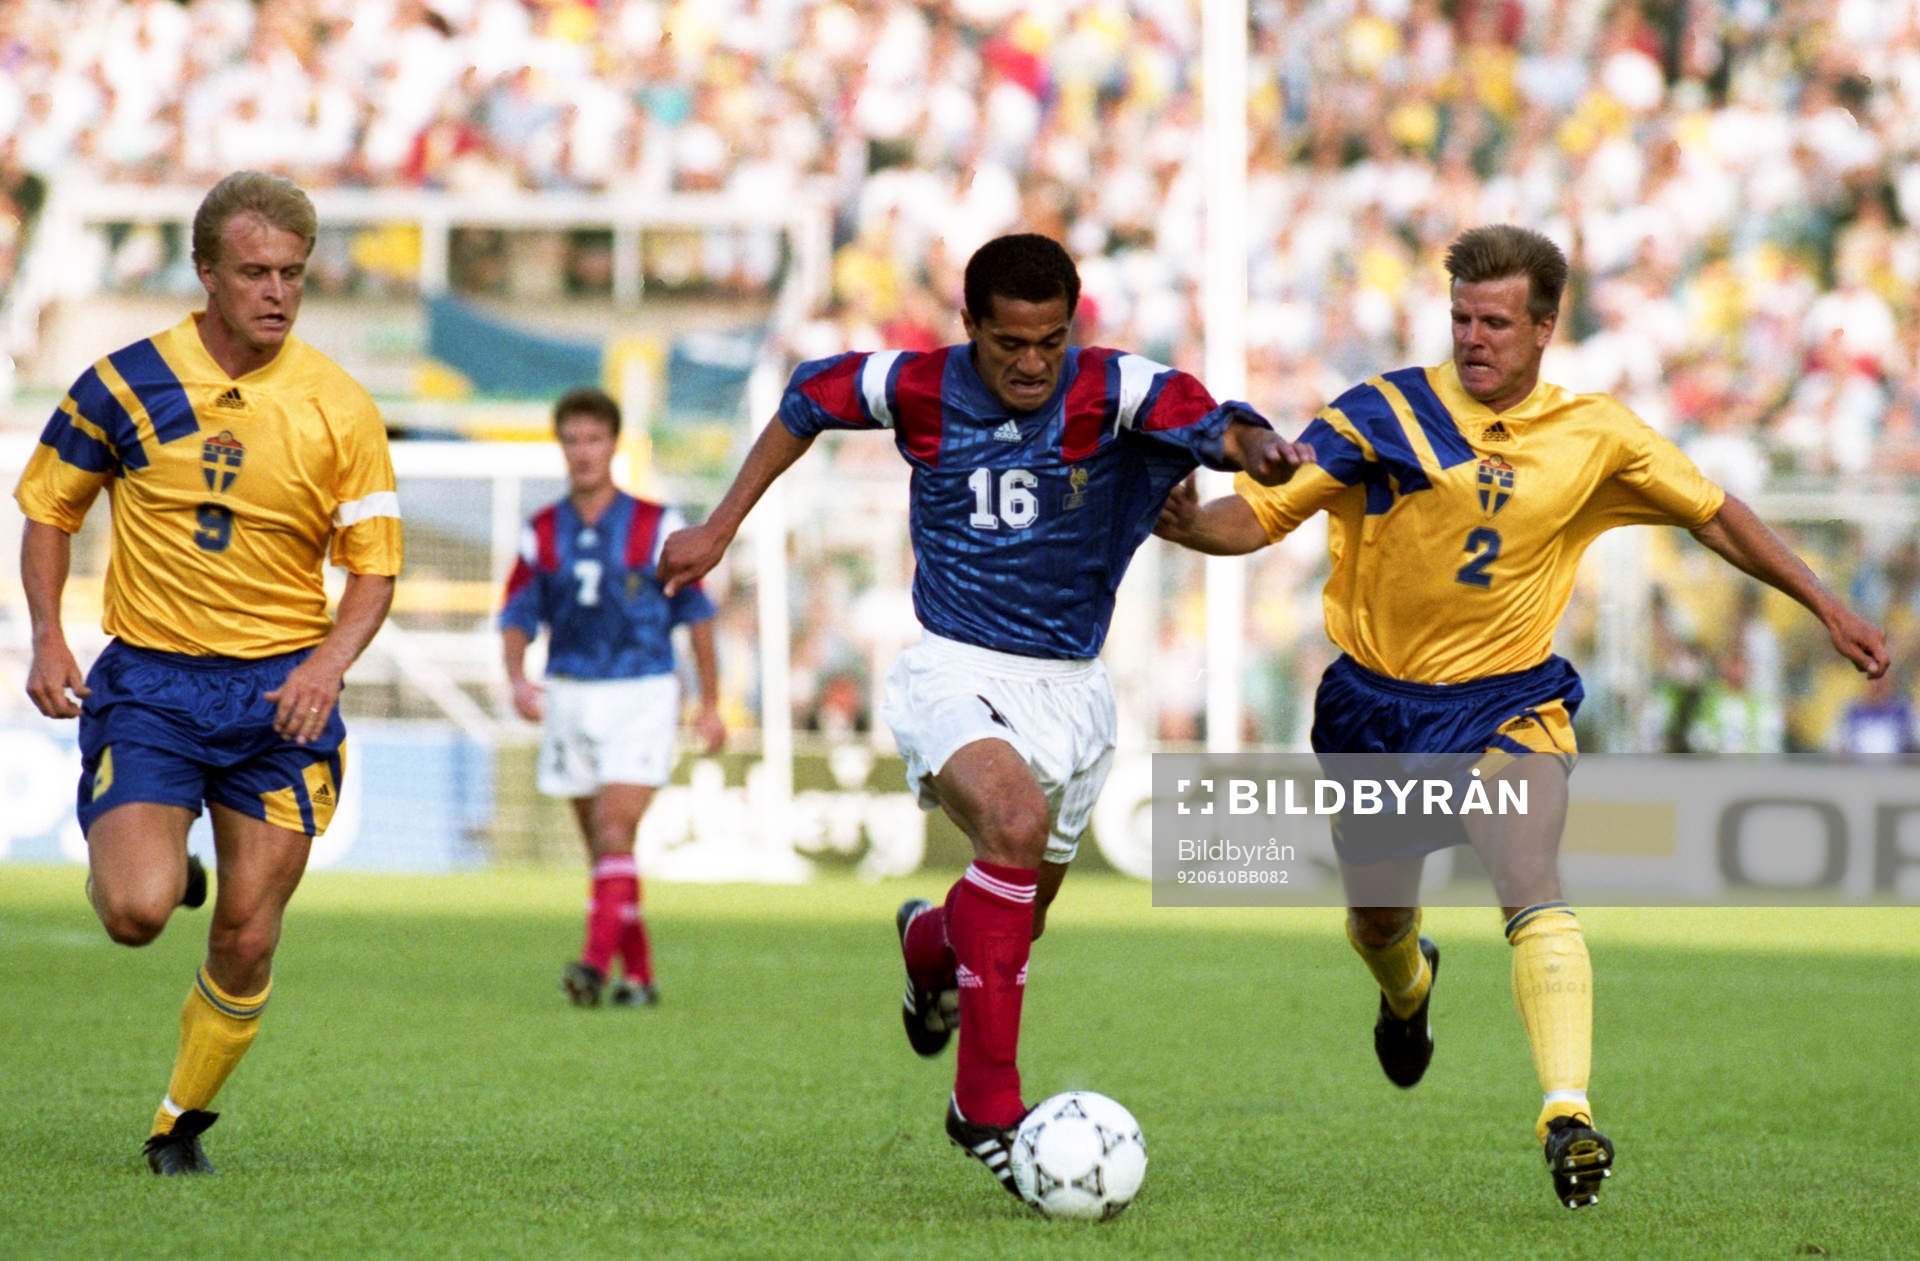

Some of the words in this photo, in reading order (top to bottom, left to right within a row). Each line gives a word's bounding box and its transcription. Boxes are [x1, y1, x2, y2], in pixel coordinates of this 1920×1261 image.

[968, 467, 1040, 530] 16
[193, 502, 233, 552] 9
[573, 558, 603, 606] 7
[1455, 525, 1503, 589] 2
